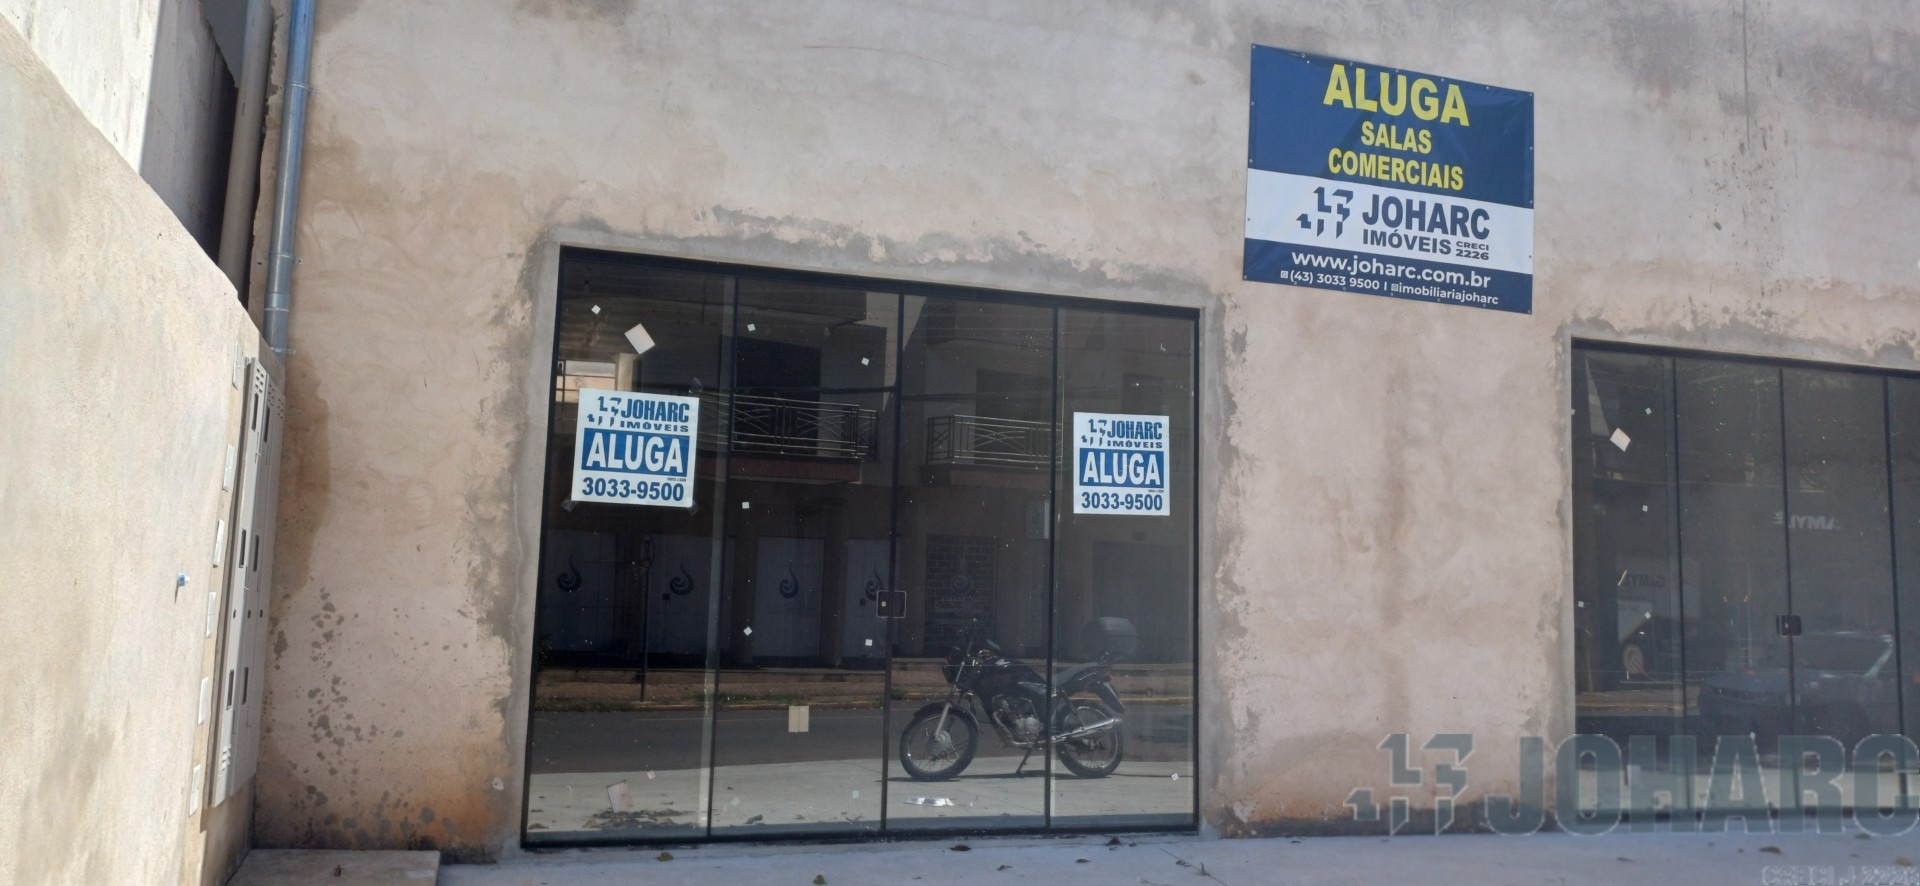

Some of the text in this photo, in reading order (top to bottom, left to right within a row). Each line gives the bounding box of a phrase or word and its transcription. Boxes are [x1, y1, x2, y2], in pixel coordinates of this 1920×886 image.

[1323, 64, 1470, 126] ALUGA
[1361, 121, 1431, 154] SALAS
[1328, 148, 1463, 190] COMERCIAIS
[1362, 194, 1490, 240] JOHARC
[1362, 229, 1452, 255] IMÓVEIS
[1455, 249, 1489, 261] 2226
[1456, 240, 1489, 251] CRECI
[1291, 252, 1491, 288] www.joharc.com.br
[1290, 269, 1313, 284] (43)
[1317, 273, 1347, 286] 3033
[1349, 276, 1380, 290] 9500
[1399, 282, 1499, 305] imobiliariajoharc
[621, 398, 690, 423] JOHARC
[620, 420, 689, 432] IMÓVEIS
[1107, 420, 1162, 440] JOHARC
[586, 432, 683, 473] ALUGA
[1107, 440, 1162, 448] IMÓVEIS
[1083, 451, 1161, 485] ALUGA
[582, 476, 684, 501] 3033-9500
[1081, 491, 1163, 511] 3033-9500
